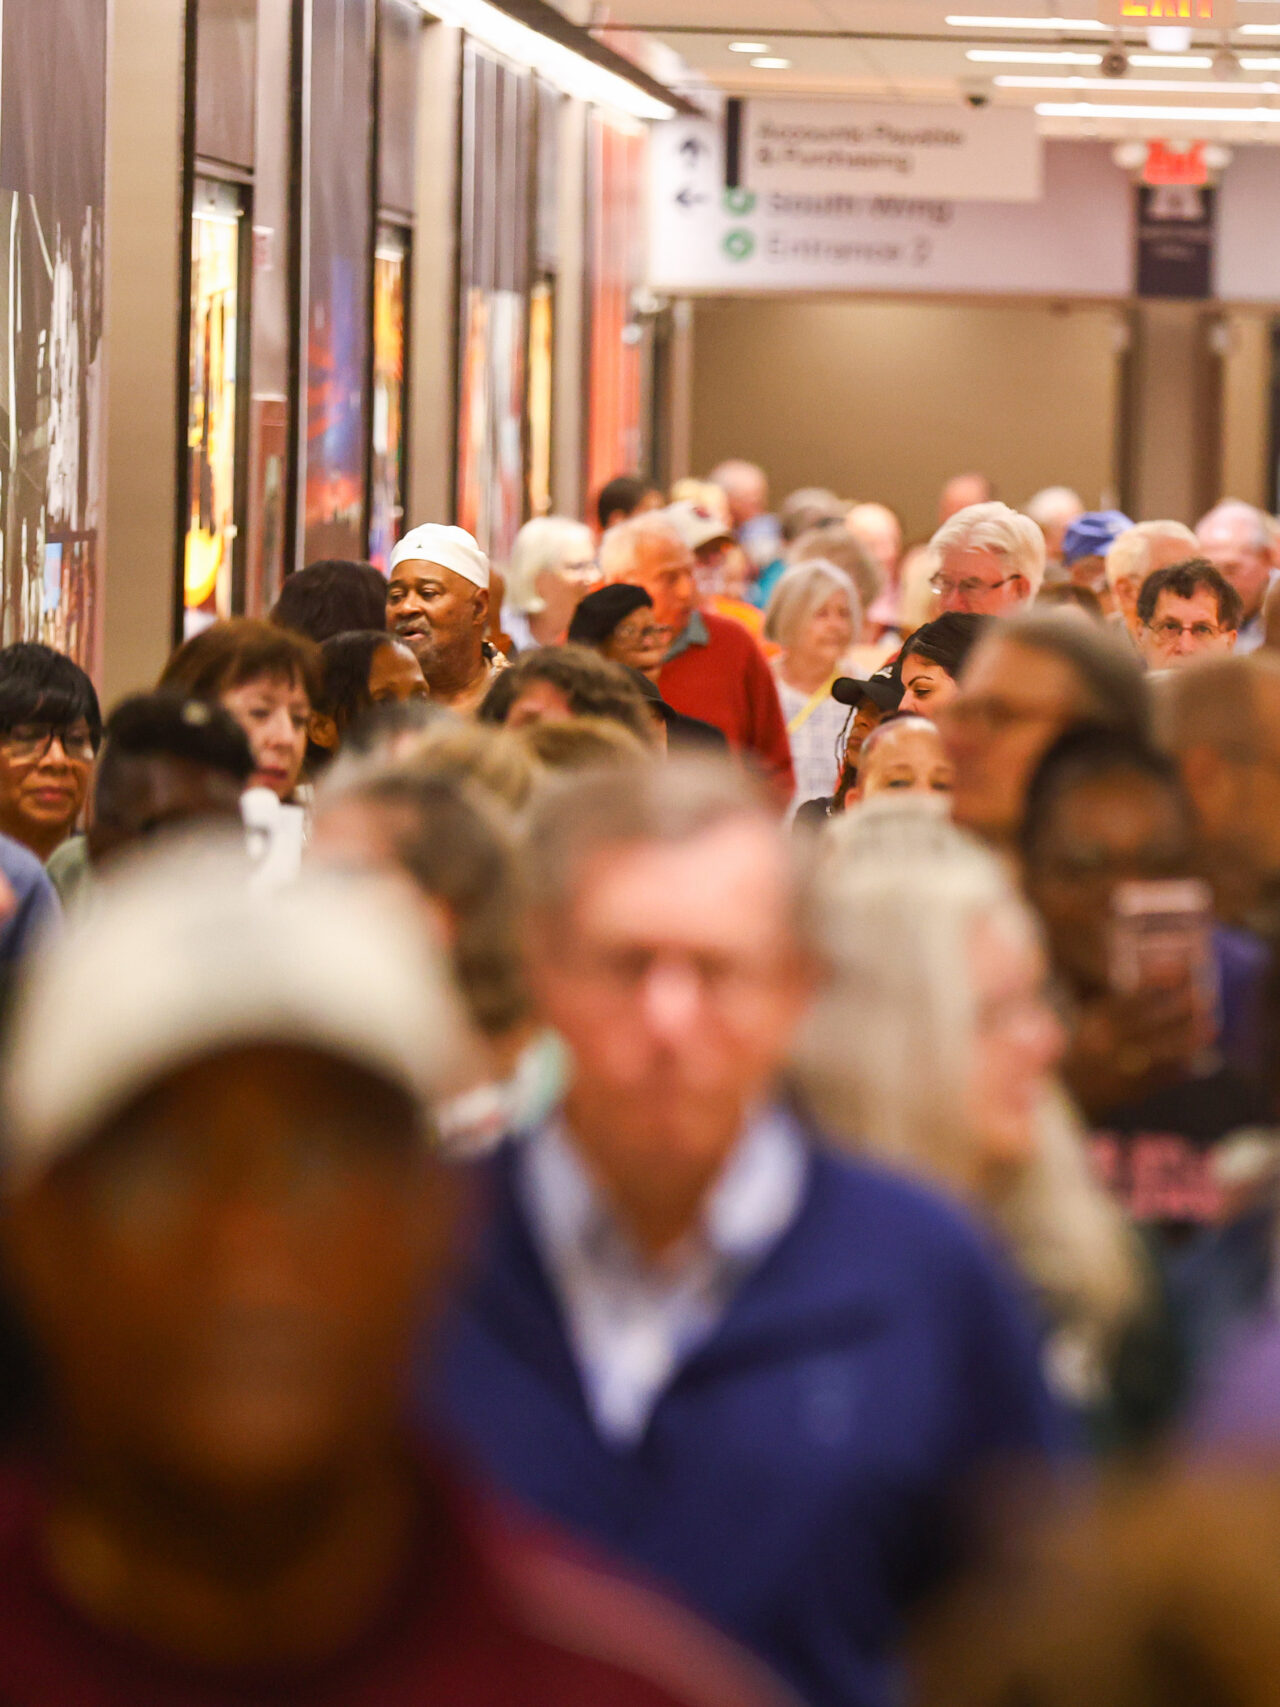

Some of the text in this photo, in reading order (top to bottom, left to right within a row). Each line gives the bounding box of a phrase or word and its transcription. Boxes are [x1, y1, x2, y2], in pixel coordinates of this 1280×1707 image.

[767, 192, 953, 225] South Wing
[767, 232, 898, 263] Entrance
